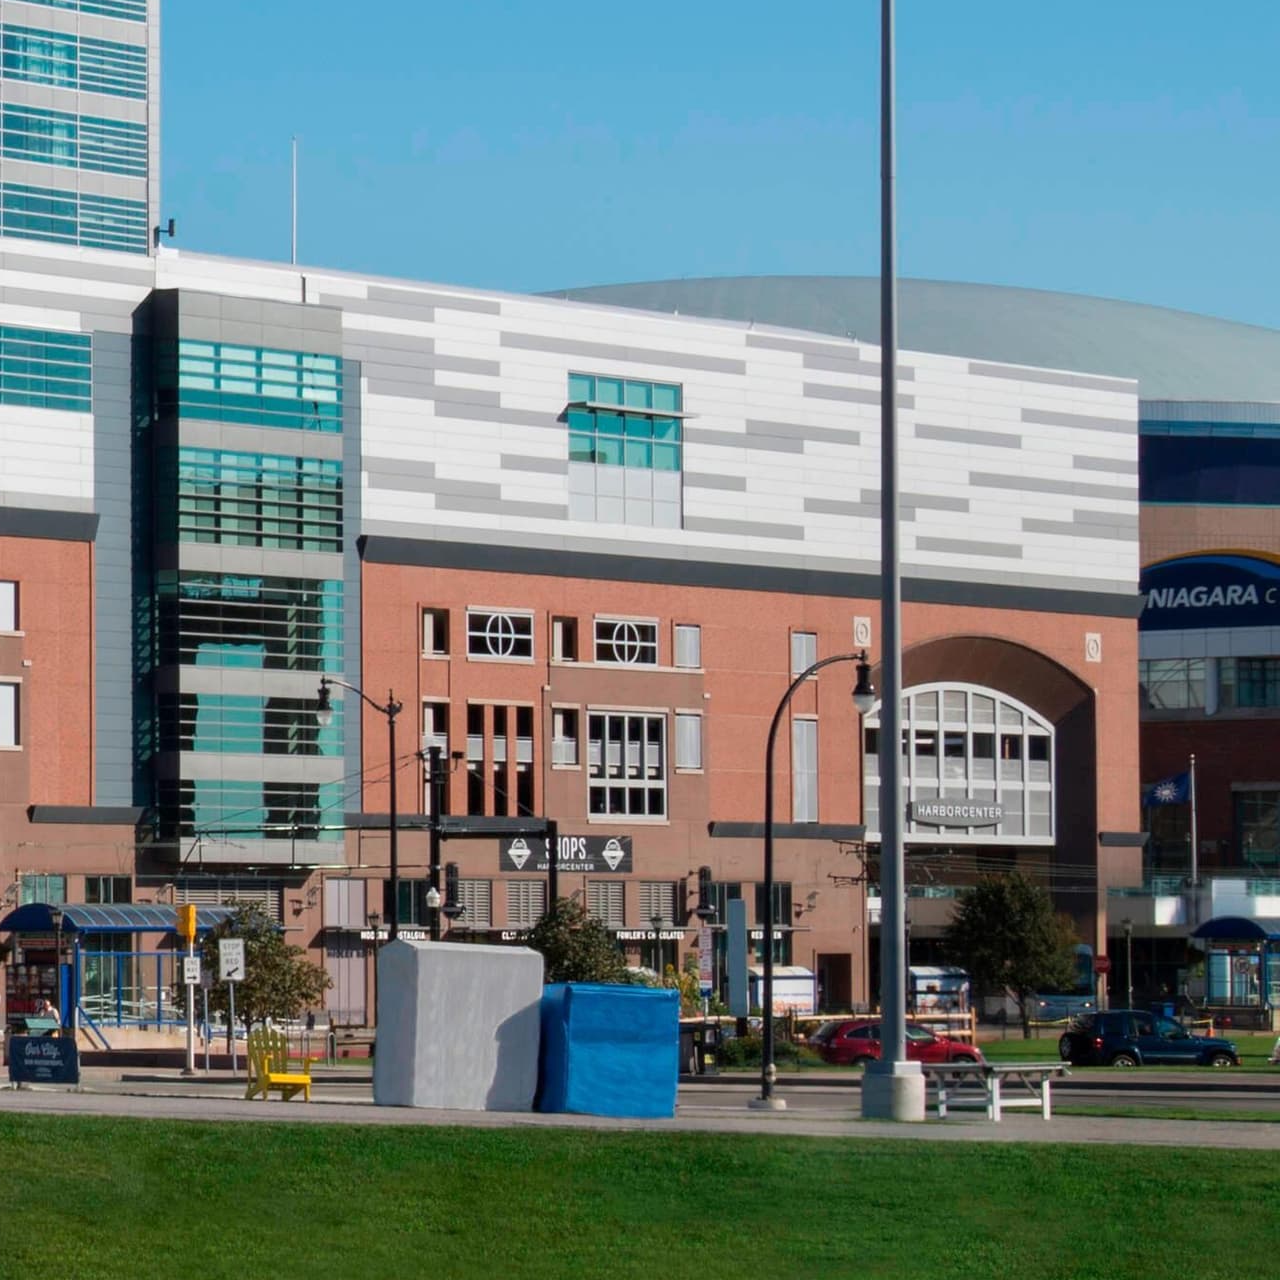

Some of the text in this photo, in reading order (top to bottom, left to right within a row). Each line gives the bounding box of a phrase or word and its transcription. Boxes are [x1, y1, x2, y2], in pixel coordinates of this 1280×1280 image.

[1148, 584, 1259, 608] NIAGARA
[918, 805, 1002, 818] HARBORCENTER
[616, 930, 685, 940] FOWLER'S CHCOLATES
